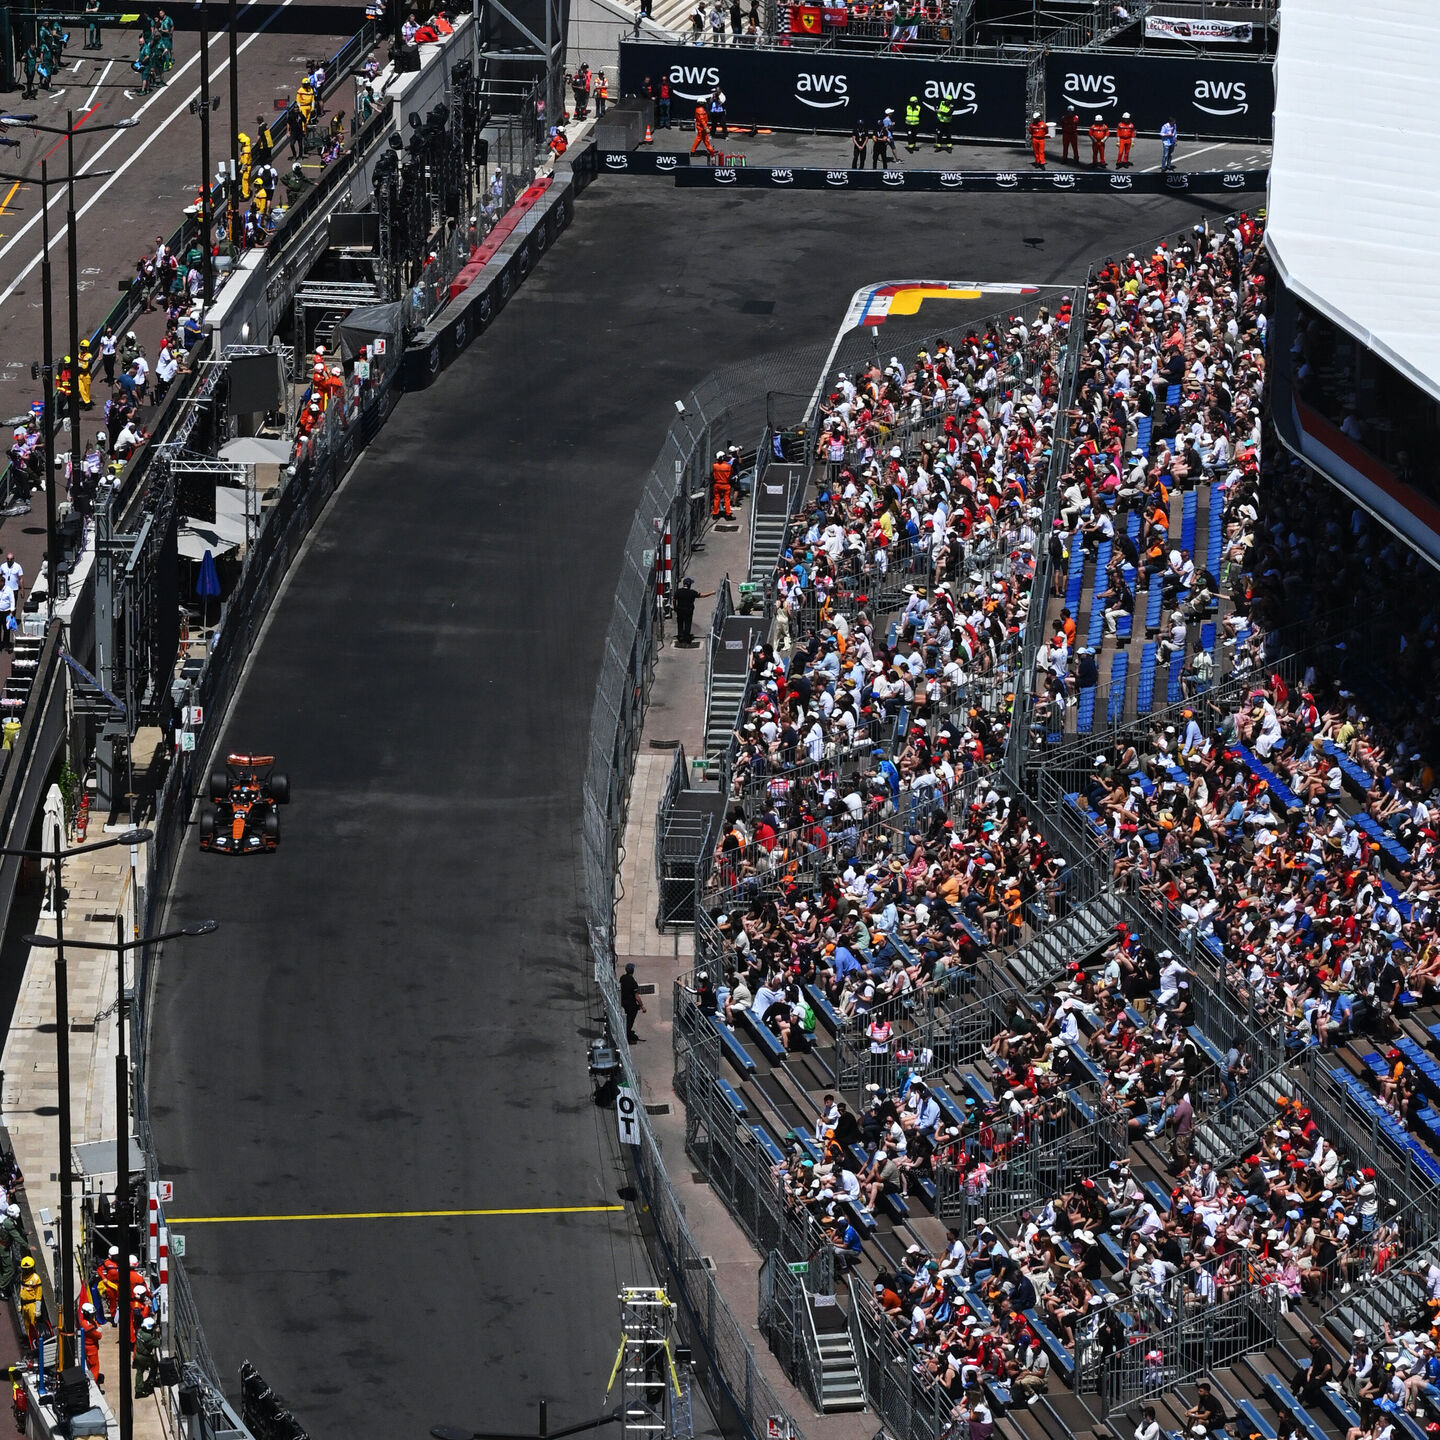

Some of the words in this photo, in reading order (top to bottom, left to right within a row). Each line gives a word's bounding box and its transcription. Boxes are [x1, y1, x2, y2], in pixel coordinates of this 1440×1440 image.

[669, 65, 720, 86] aws
[796, 73, 848, 94] aws
[1064, 73, 1116, 94] aws
[924, 80, 976, 101] aws
[1194, 80, 1247, 101] aws
[606, 154, 627, 163] aws
[656, 155, 677, 164] aws
[715, 169, 736, 177] aws
[771, 169, 793, 177] aws
[826, 170, 848, 180] aws
[883, 171, 904, 180] aws
[940, 172, 961, 181] aws
[996, 172, 1017, 181] aws
[1053, 173, 1074, 182] aws
[1223, 173, 1245, 182] aws
[1110, 173, 1131, 183] aws
[1166, 174, 1188, 183] aws
